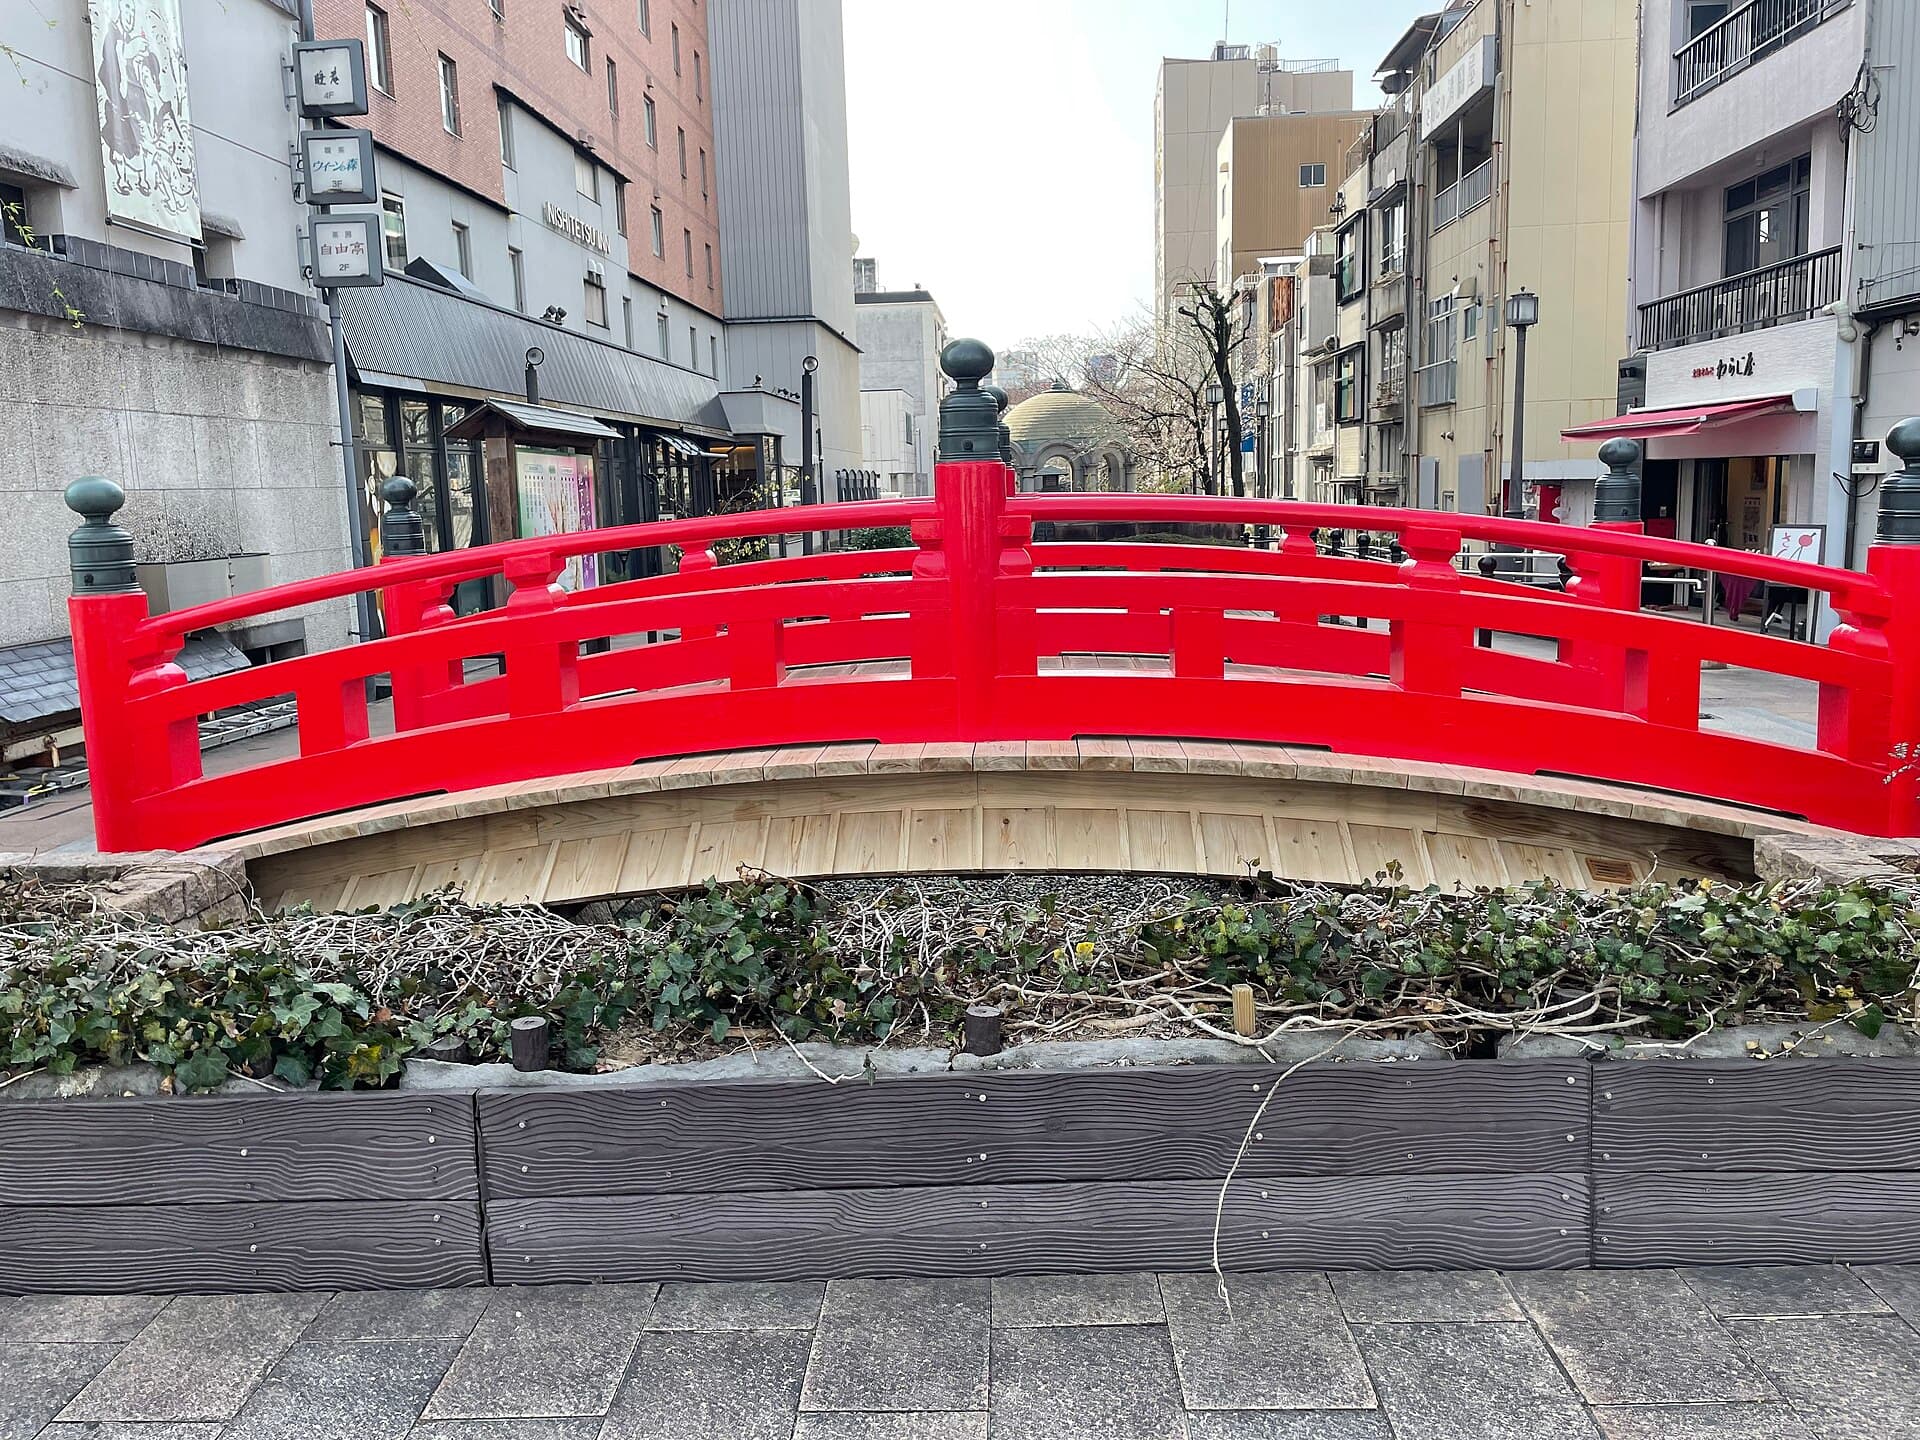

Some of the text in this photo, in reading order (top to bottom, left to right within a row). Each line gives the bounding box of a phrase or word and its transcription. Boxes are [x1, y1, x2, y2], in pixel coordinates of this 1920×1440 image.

[324, 91, 335, 99] 4F
[331, 180, 343, 188] 3F
[547, 201, 596, 246] NISHITETSU
[1716, 351, 1756, 380] わらじ屋
